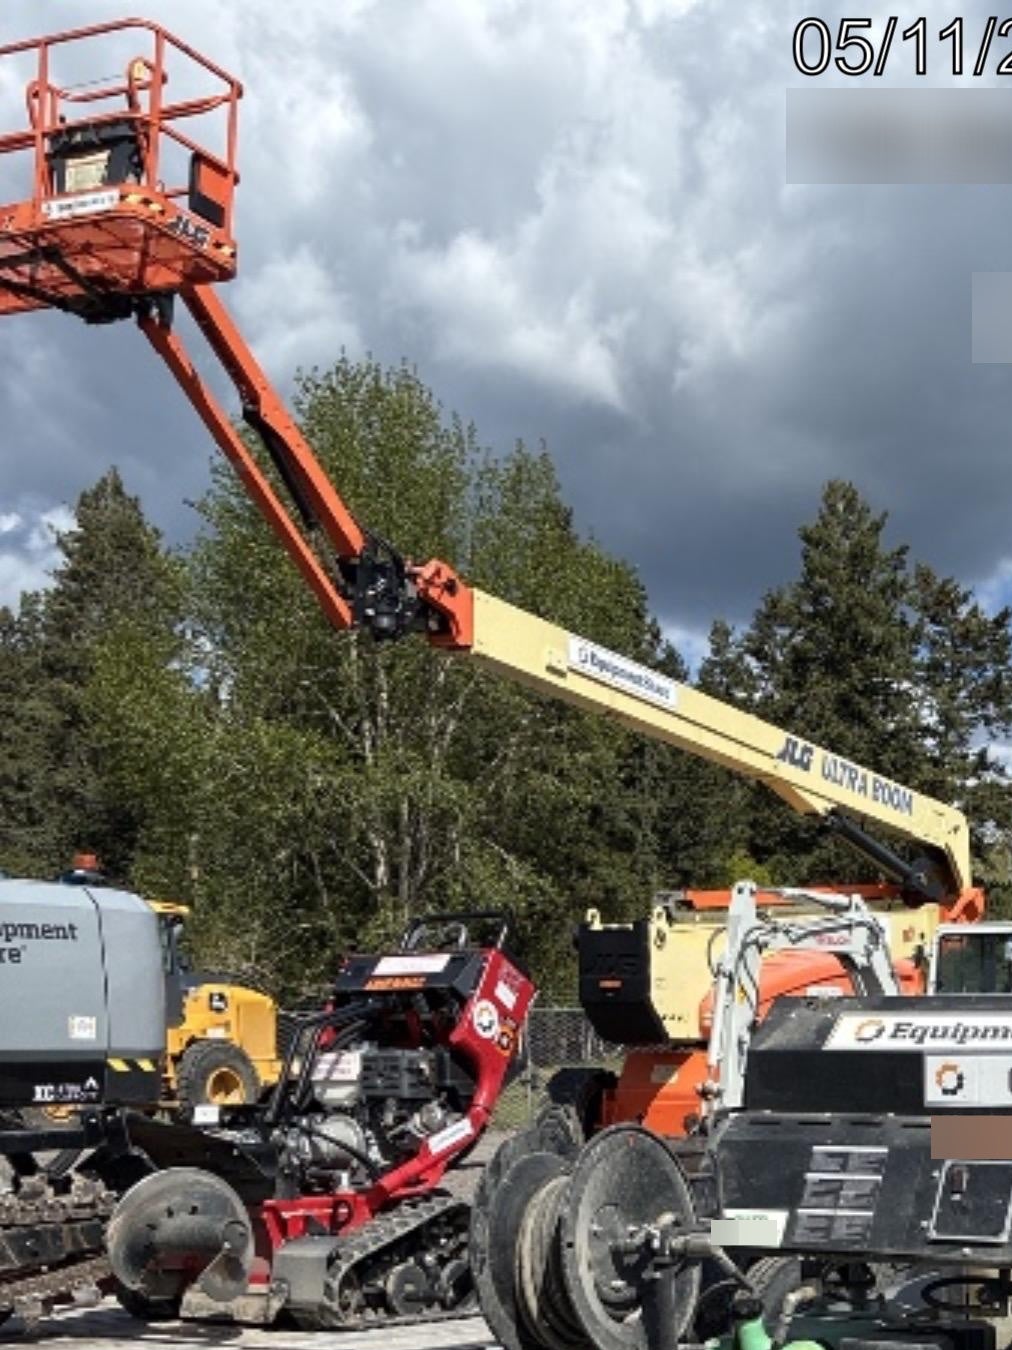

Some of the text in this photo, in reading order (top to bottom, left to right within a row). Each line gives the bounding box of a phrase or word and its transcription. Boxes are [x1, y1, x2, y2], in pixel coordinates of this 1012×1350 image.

[777, 737, 913, 816] JLG ULTRA BOOM
